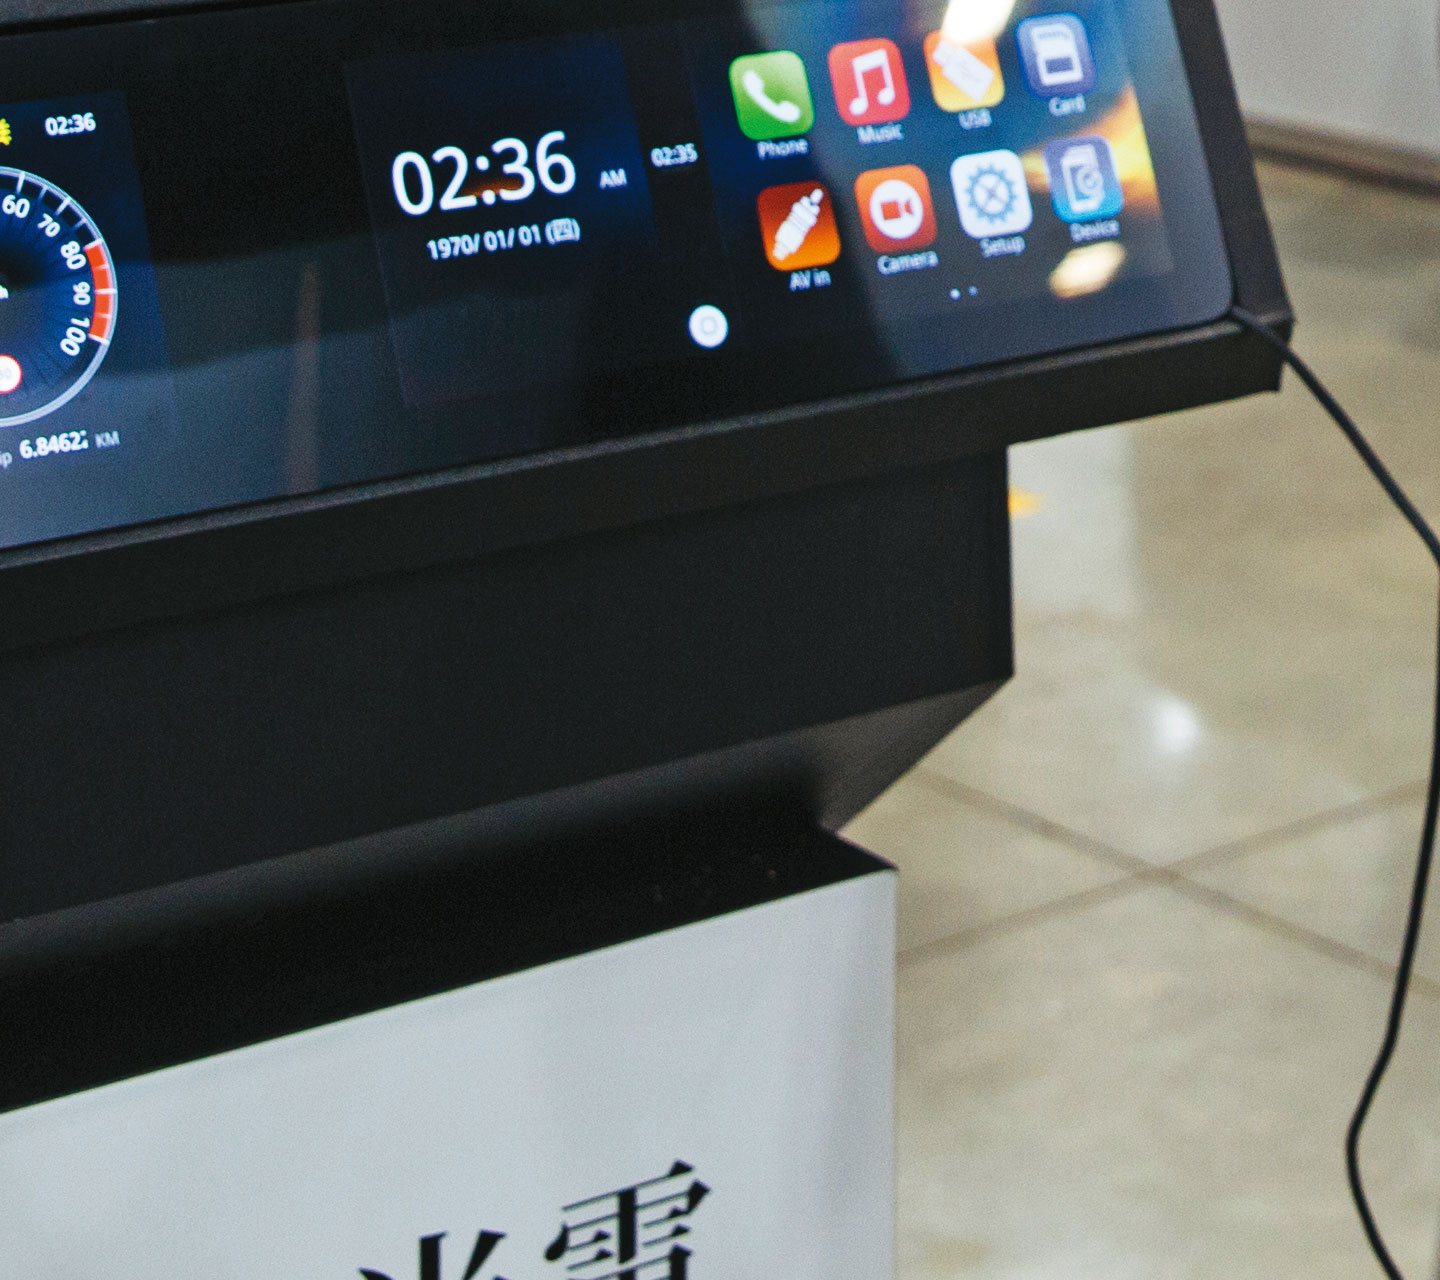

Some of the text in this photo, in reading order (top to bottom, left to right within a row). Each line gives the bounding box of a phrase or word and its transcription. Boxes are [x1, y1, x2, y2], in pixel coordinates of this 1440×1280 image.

[1048, 95, 1086, 116] Card
[44, 111, 97, 136] 02:36
[958, 108, 992, 130] USB
[856, 121, 903, 145] Music
[756, 138, 809, 160] Phone
[391, 129, 629, 217] 02:36 AM
[1, 194, 31, 219] 60
[37, 213, 61, 239] 70
[1069, 218, 1121, 242] Device
[60, 240, 87, 270] 80
[978, 235, 1026, 260] Setup
[876, 250, 939, 276] Camera
[71, 280, 92, 306] 90
[789, 271, 812, 291] AV
[59, 315, 91, 357] 100
[94, 430, 121, 449] KM
